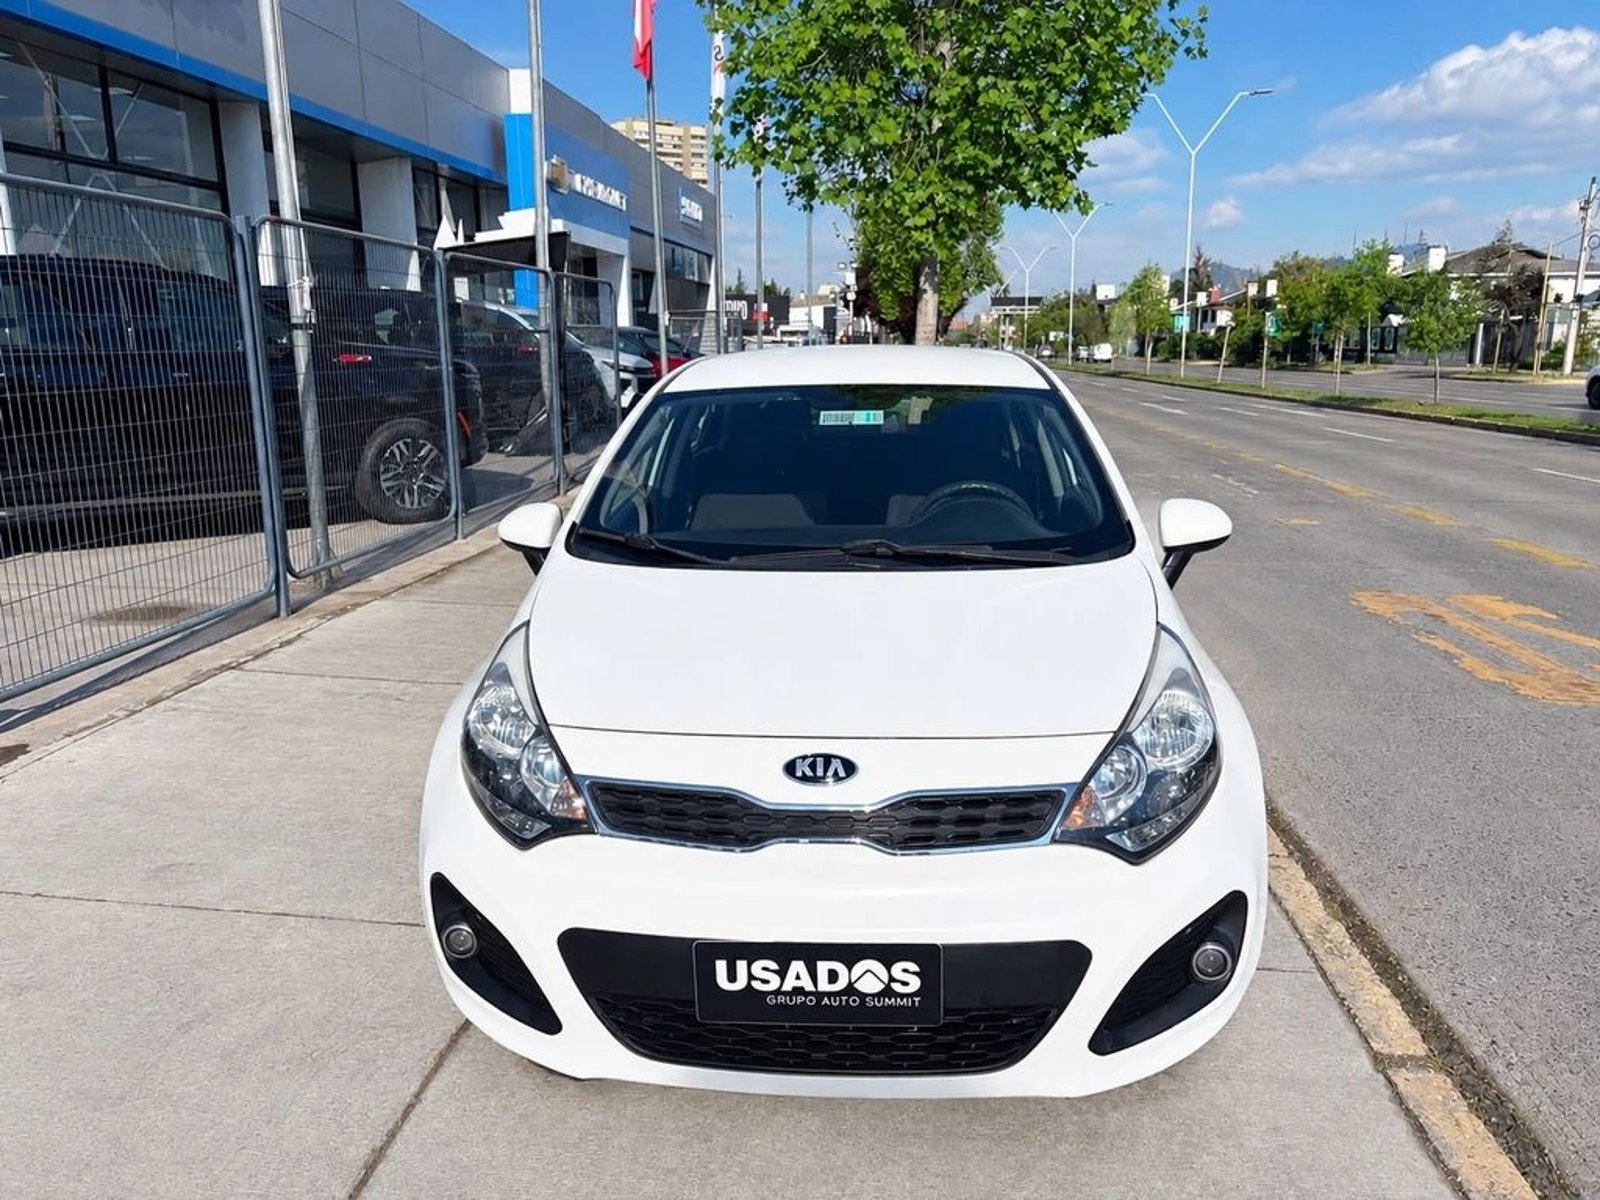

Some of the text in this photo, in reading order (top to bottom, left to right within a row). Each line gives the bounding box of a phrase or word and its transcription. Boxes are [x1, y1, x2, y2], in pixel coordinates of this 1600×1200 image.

[795, 757, 847, 777] KIA
[715, 958, 921, 995] USADOS
[766, 995, 922, 1008] GRUPO AUTO SUMMIT
